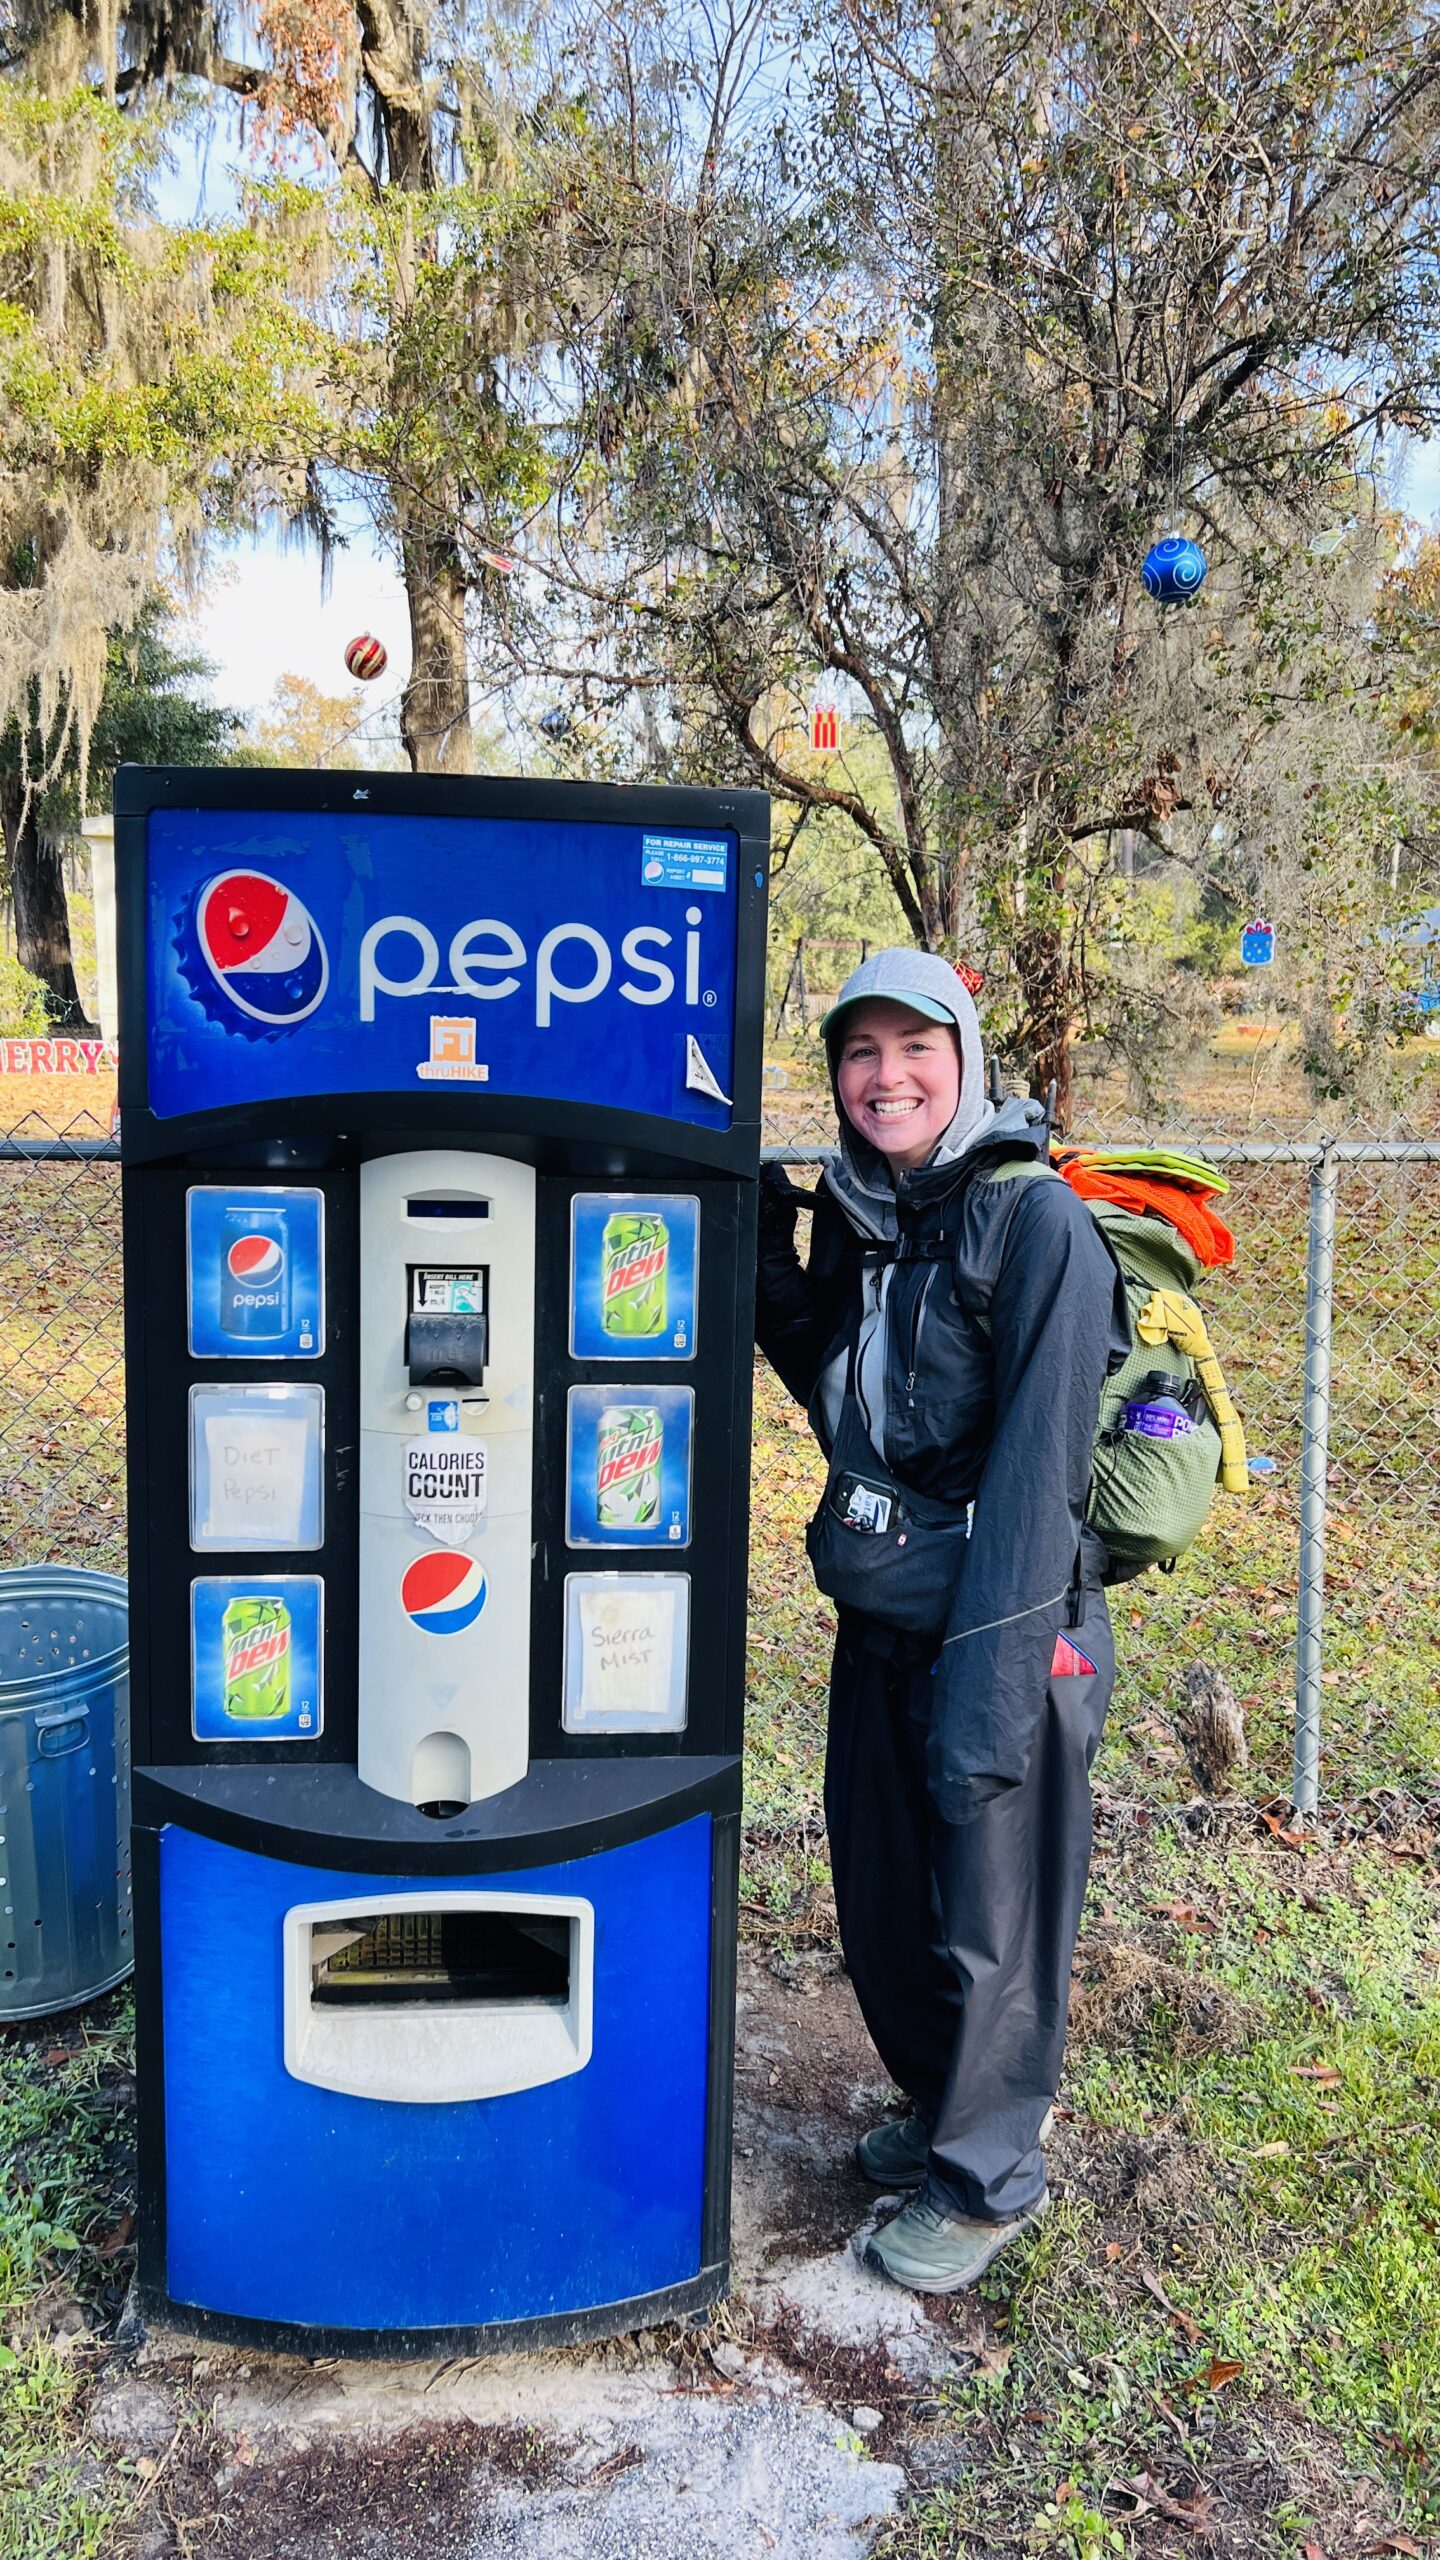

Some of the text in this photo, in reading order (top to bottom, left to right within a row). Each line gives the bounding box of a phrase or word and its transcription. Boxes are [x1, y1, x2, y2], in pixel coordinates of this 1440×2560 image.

[646, 838, 725, 852] FOR REPAIR SERVICE
[435, 1026, 474, 1056] FT
[0, 1039, 104, 1075] ERRY
[419, 1063, 487, 1079] thruHIKE
[233, 1291, 280, 1309] pepsi
[301, 1319, 310, 1328] 12
[676, 1319, 686, 1328] 12
[408, 1452, 485, 1470] CALORIES
[408, 1473, 484, 1499] COUNT
[434, 1513, 453, 1525] THEN
[671, 1510, 680, 1519] 12
[591, 1625, 655, 1648] Sierra
[301, 1700, 310, 1709] 12
